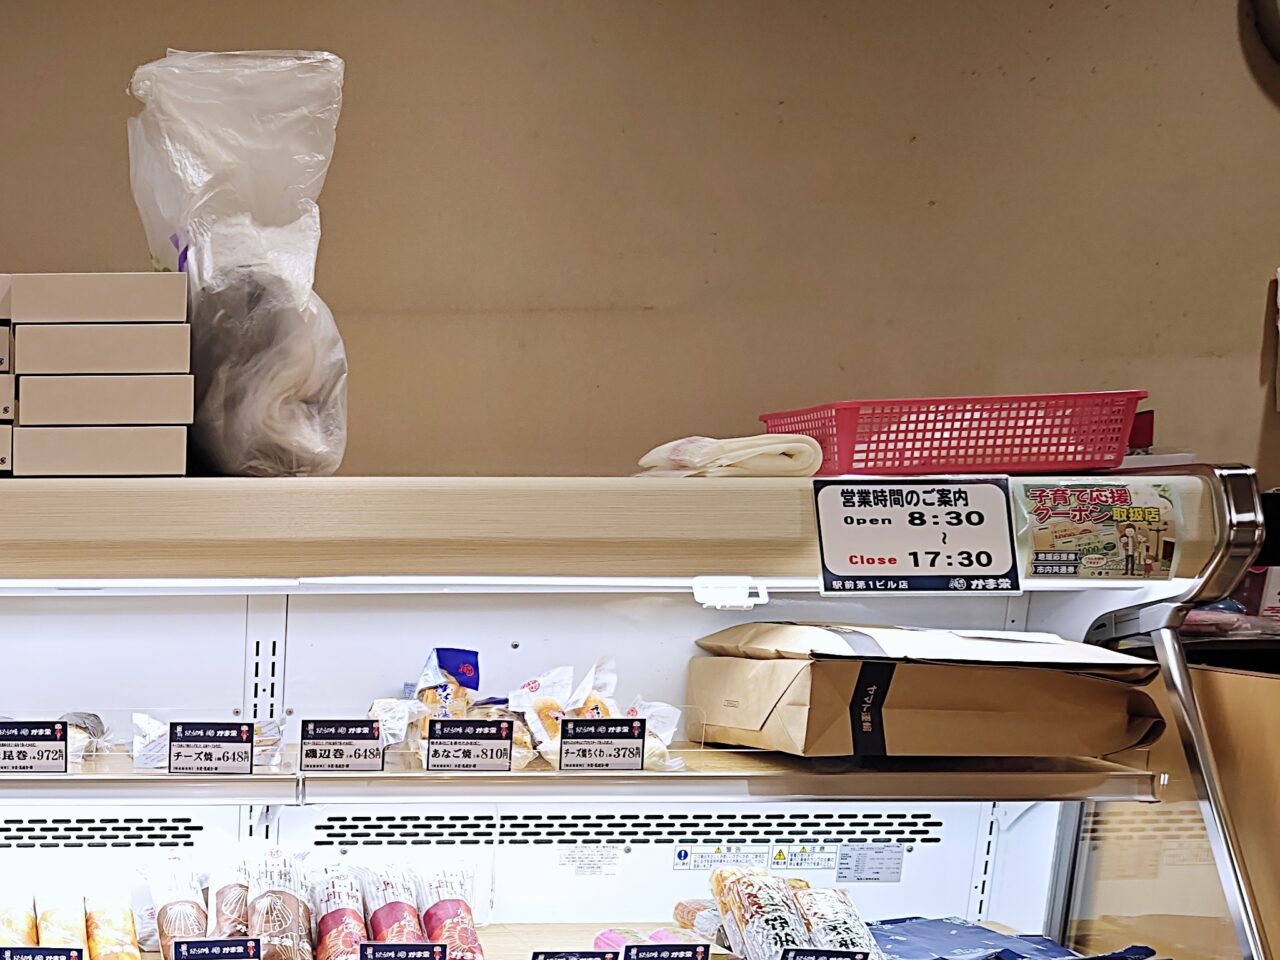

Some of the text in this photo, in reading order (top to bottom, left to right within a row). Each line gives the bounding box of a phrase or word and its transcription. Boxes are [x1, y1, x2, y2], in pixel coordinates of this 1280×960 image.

[841, 488, 969, 508] 営業時間のご案内
[1029, 487, 1132, 506] 子育て応援
[843, 510, 985, 526] Open 8:30
[1032, 505, 1161, 524] クーポン 取扱店
[848, 550, 993, 567] Close 17:30
[832, 580, 909, 590] 駅前第1ビル店
[970, 578, 1012, 590] かま栄
[173, 751, 213, 762] チーズ焼
[431, 748, 472, 759] あなご焼
